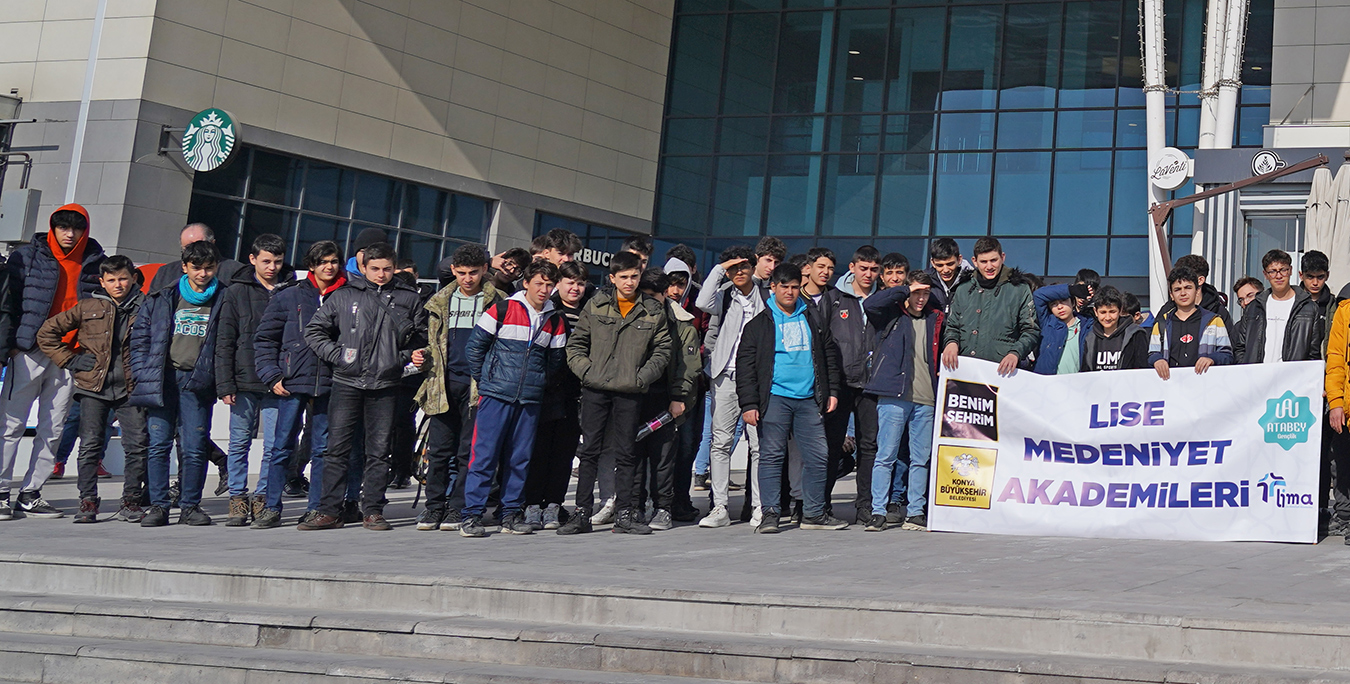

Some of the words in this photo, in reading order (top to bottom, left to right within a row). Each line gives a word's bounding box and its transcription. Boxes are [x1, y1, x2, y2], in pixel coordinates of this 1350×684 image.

[1150, 160, 1187, 180] LaVenti
[573, 248, 615, 267] RBUC
[174, 323, 207, 338] ACOS
[1266, 422, 1307, 433] ATABEY
[952, 478, 976, 487] KONYA
